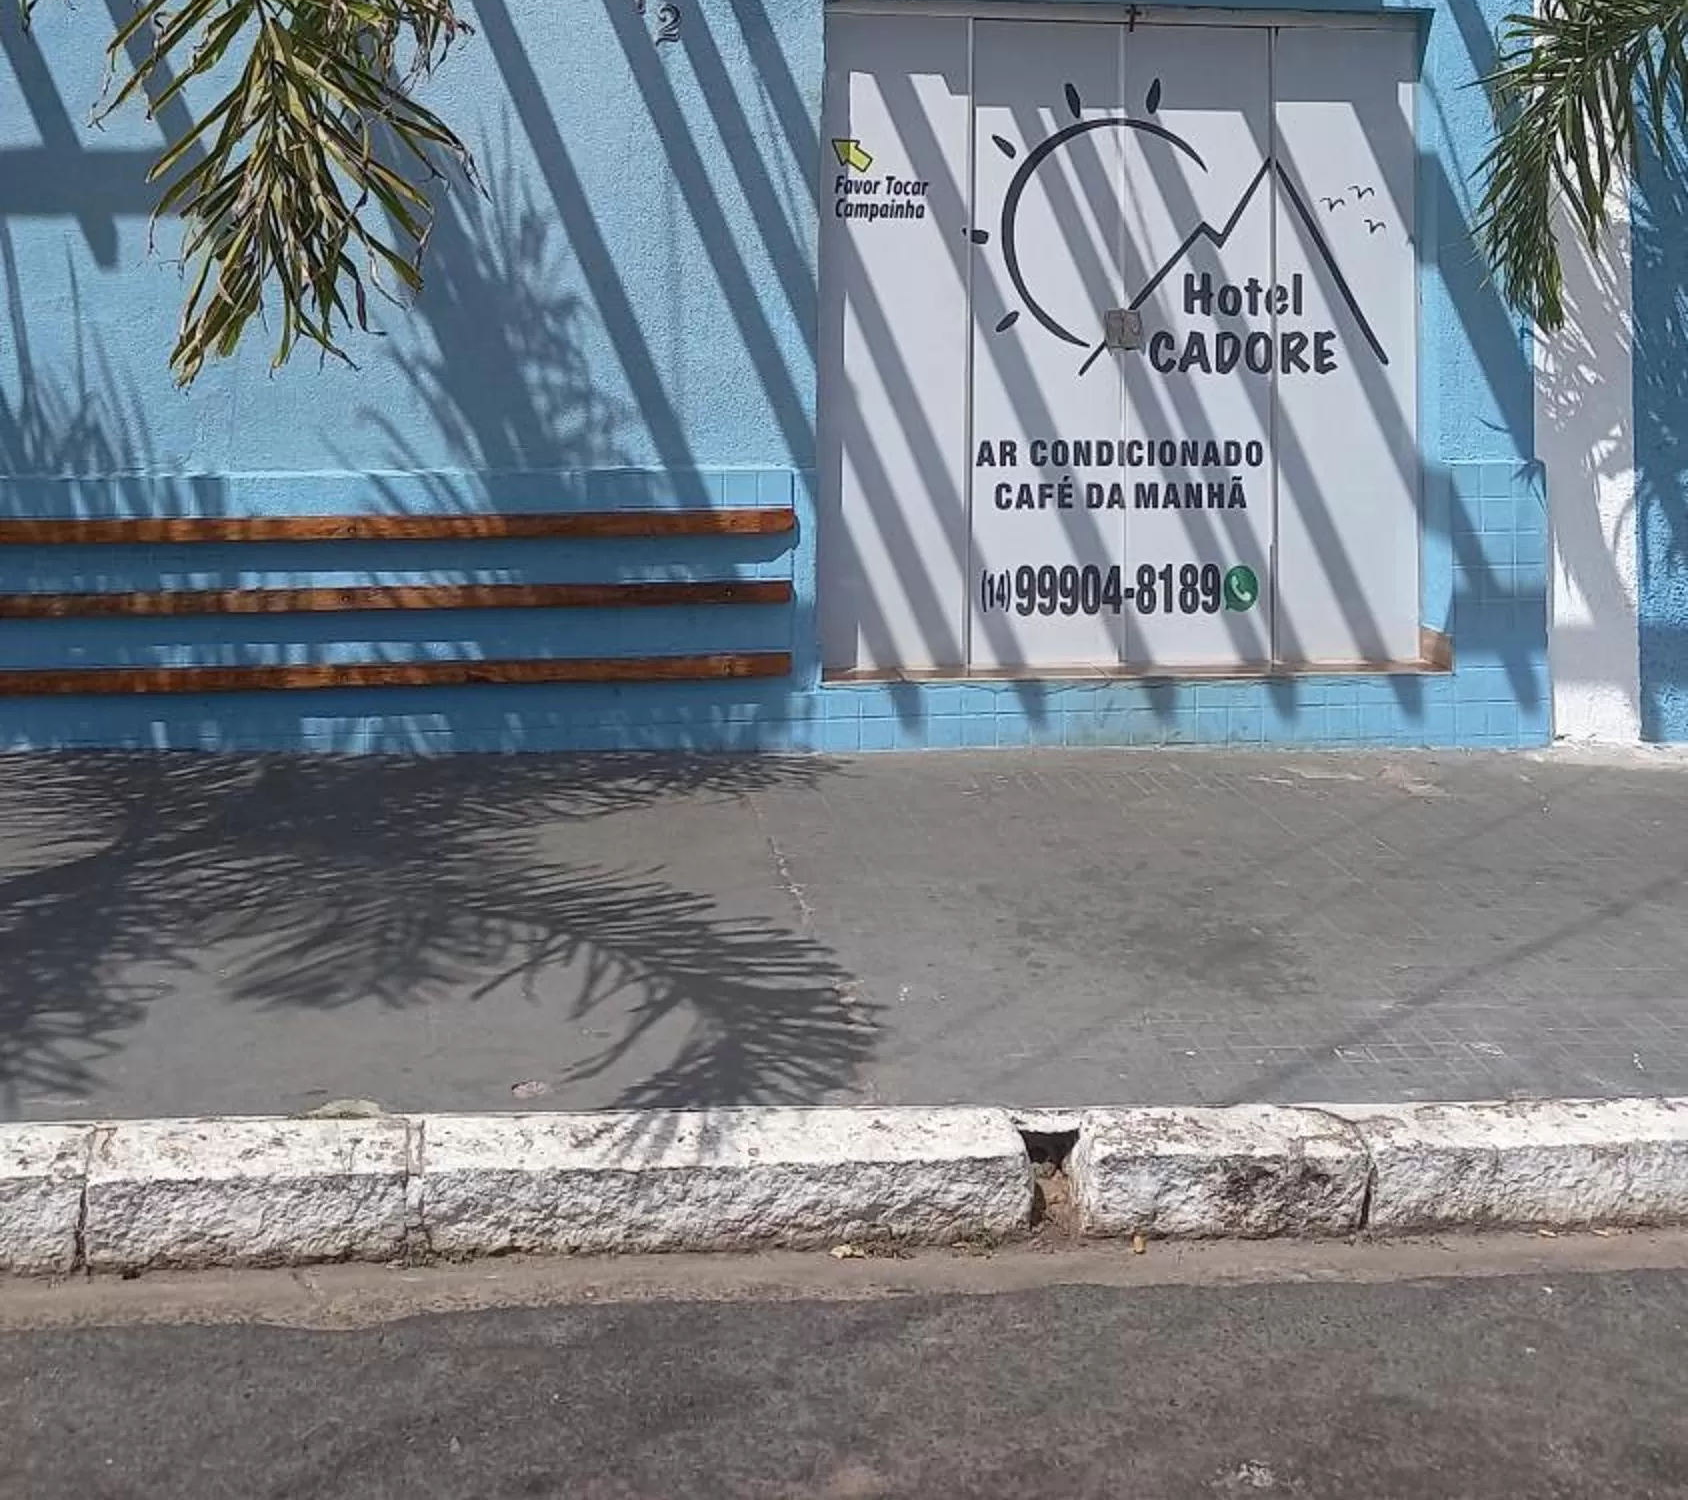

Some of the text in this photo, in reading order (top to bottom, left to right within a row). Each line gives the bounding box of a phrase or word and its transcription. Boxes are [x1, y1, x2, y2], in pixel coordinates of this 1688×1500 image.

[835, 175, 929, 196] Favor Tocar
[835, 198, 925, 222] Campainha
[1184, 272, 1303, 316] Hotel
[1150, 331, 1338, 375] CADORE
[976, 439, 1264, 468] AR CONDICIONADO
[995, 476, 1247, 510] CAFÉ DA MANHÃ
[981, 563, 1222, 617] (14) 99904-8189
